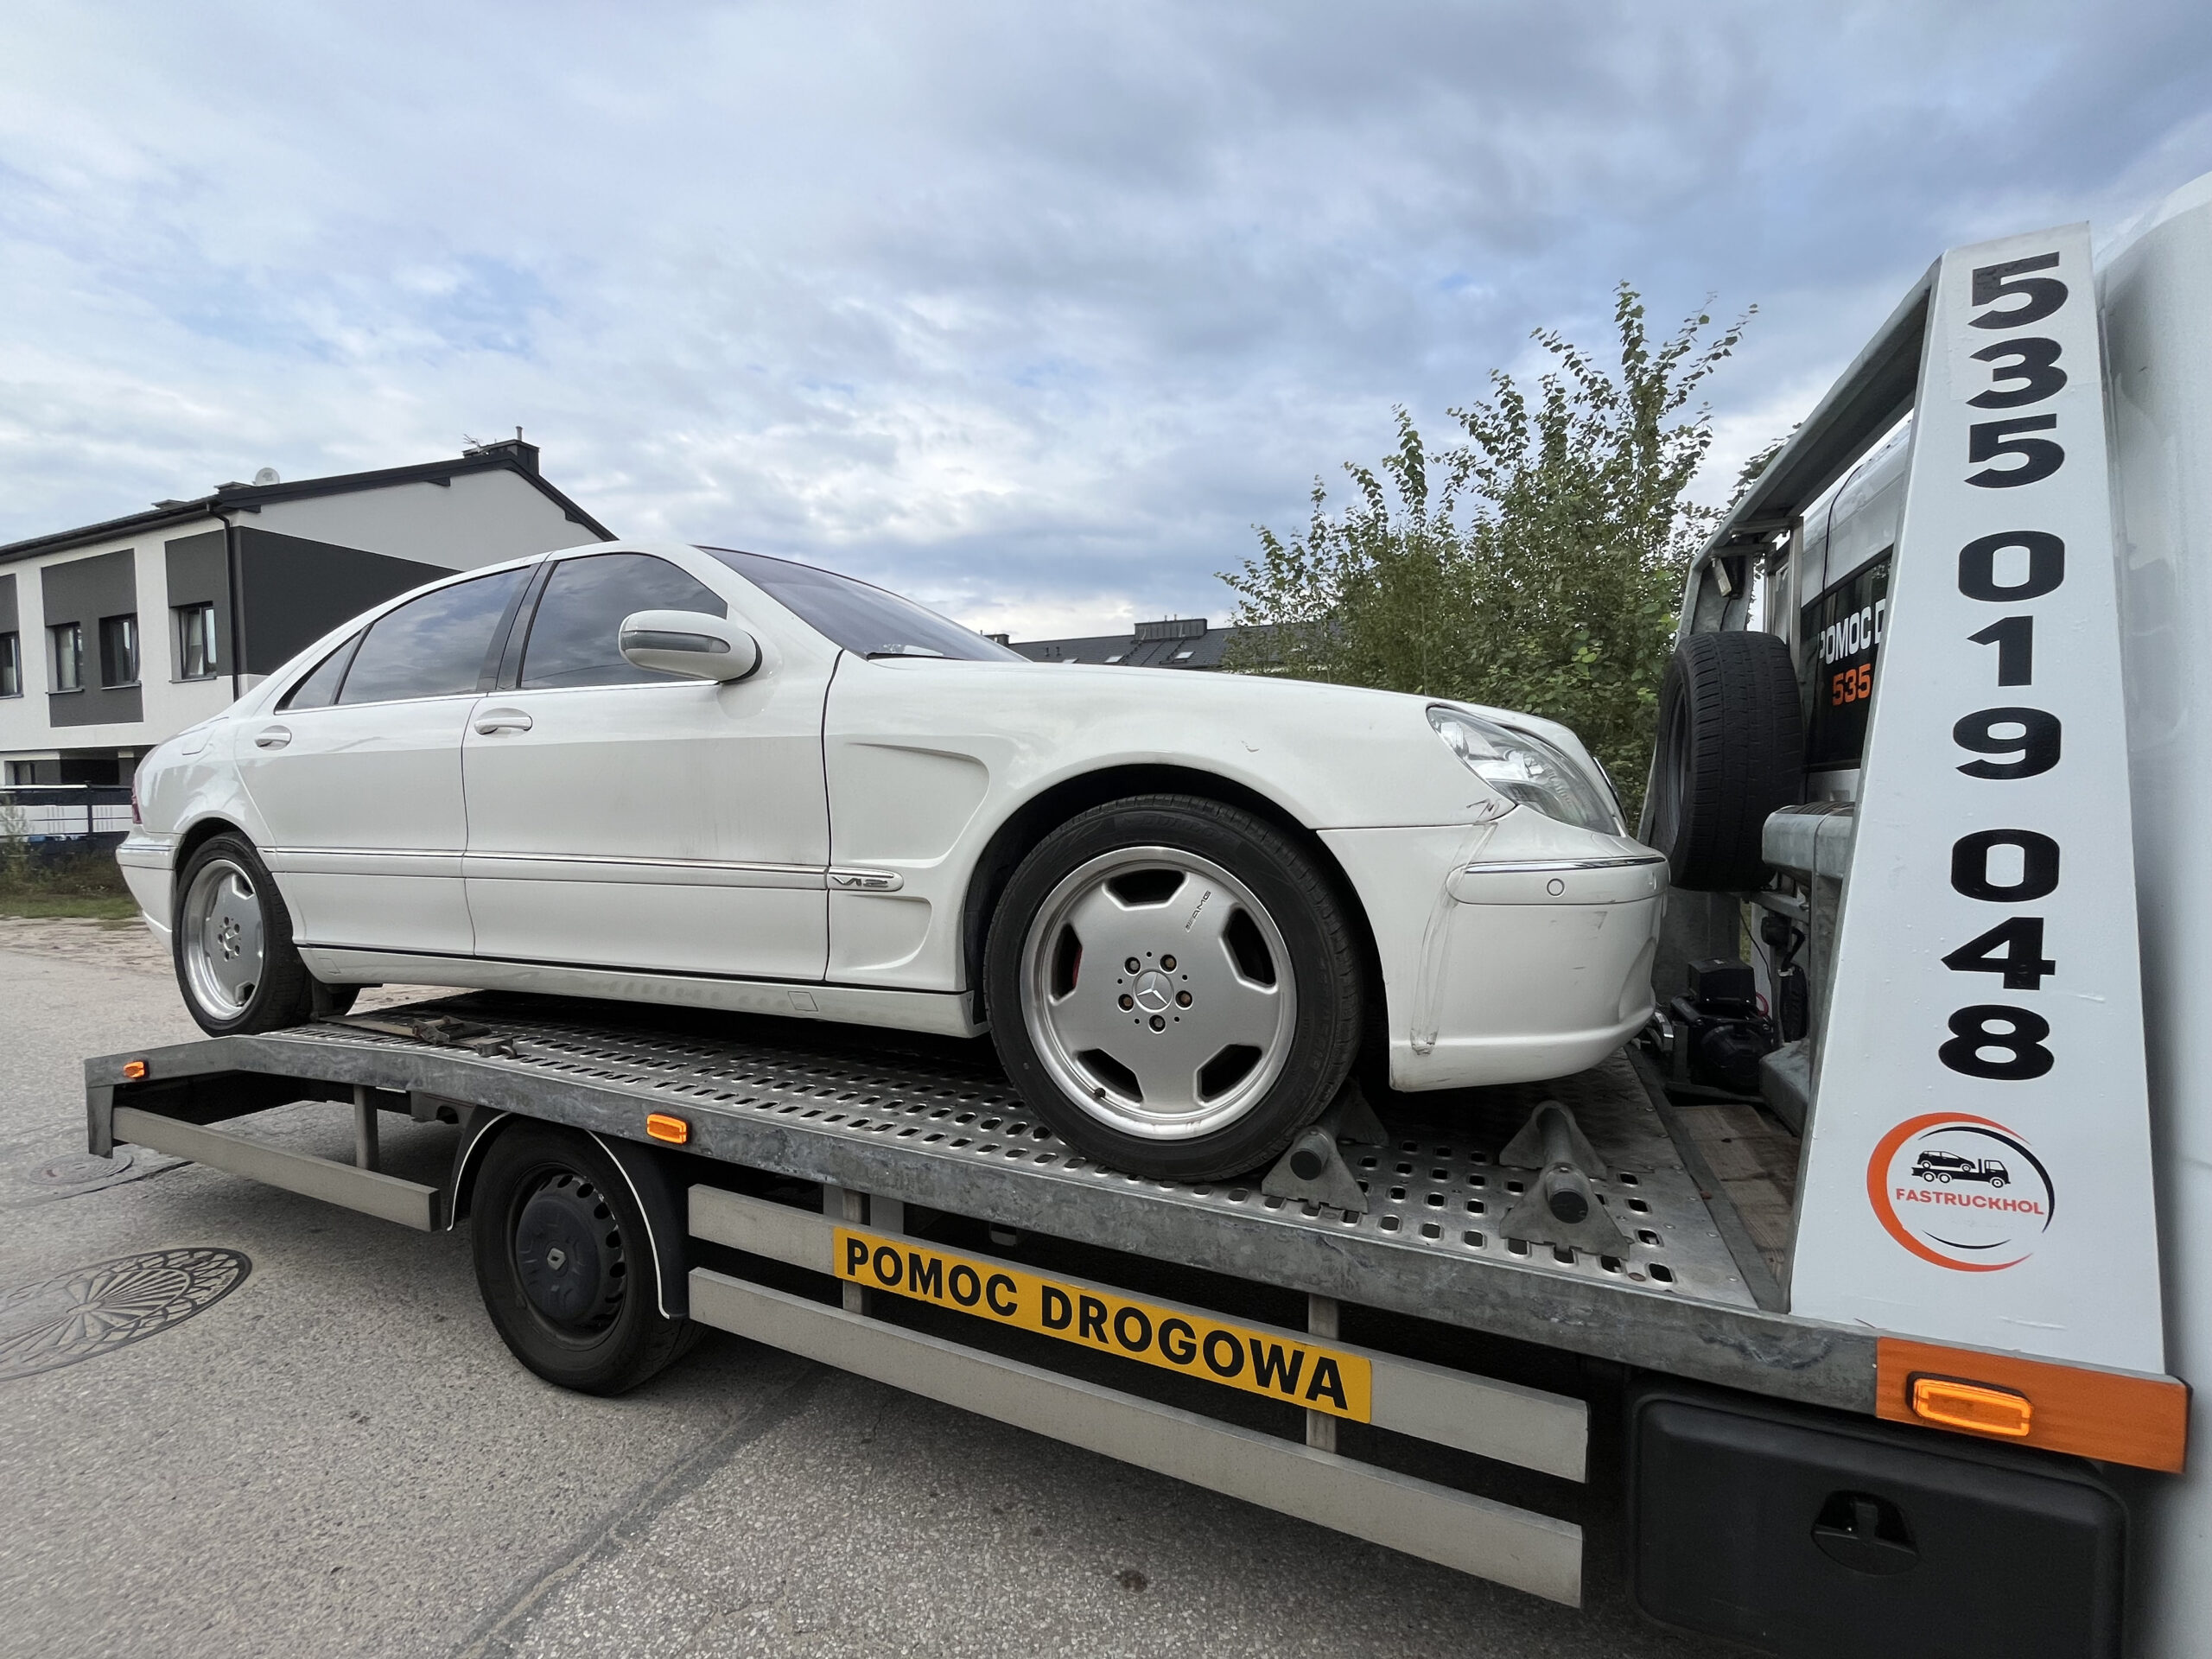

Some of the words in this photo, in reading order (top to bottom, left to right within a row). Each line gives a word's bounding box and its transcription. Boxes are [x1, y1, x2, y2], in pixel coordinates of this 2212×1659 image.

[1963, 251, 2069, 488] 535
[1818, 607, 1872, 664] POMOC
[1832, 664, 1872, 707] 535
[1953, 531, 2065, 780] 019
[1938, 829, 2061, 1081] 048
[1896, 1188, 2044, 1215] FASTRUCKHOL
[847, 1237, 1018, 1317] POMOC
[1041, 1287, 1350, 1412] DROGOWA
